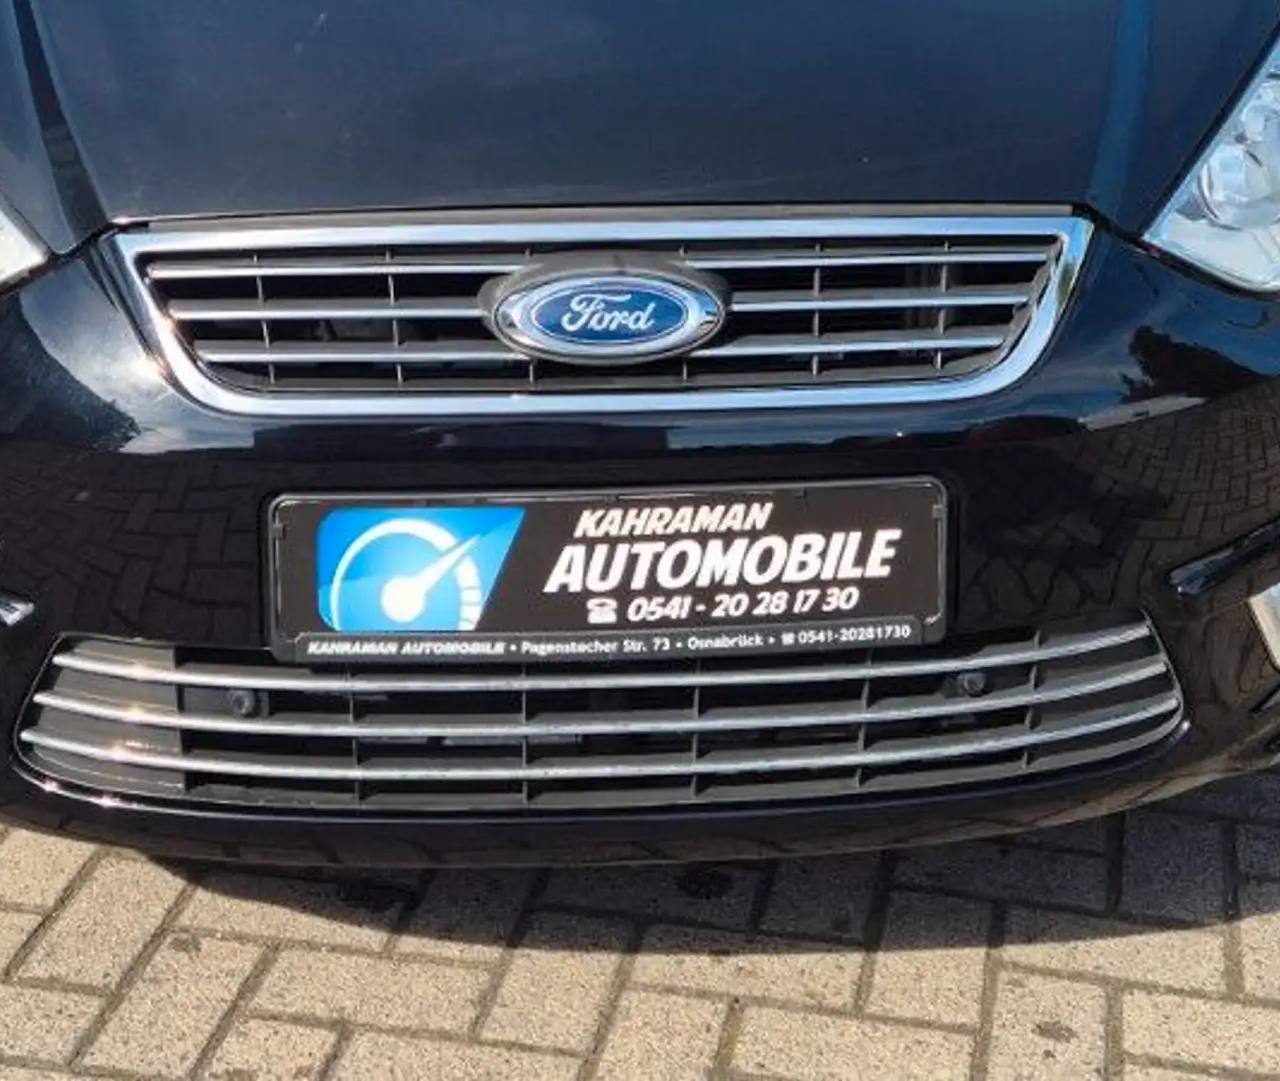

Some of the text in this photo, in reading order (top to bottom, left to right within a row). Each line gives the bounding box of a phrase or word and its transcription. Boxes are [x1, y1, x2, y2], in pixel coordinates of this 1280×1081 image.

[561, 293, 656, 332] Ford
[573, 501, 773, 538] KAHRAMAN
[542, 528, 903, 593] AUTOMOBILE
[626, 596, 694, 622] 0541
[711, 593, 750, 618] 20
[752, 590, 788, 615] 28
[792, 588, 820, 613] 17
[820, 585, 860, 612] 30
[306, 640, 399, 656] KAHRAMAN
[400, 640, 506, 656] AUTOMOBILE
[622, 635, 648, 653] Str.
[652, 634, 671, 651] 73
[687, 632, 764, 651] Osnabrück
